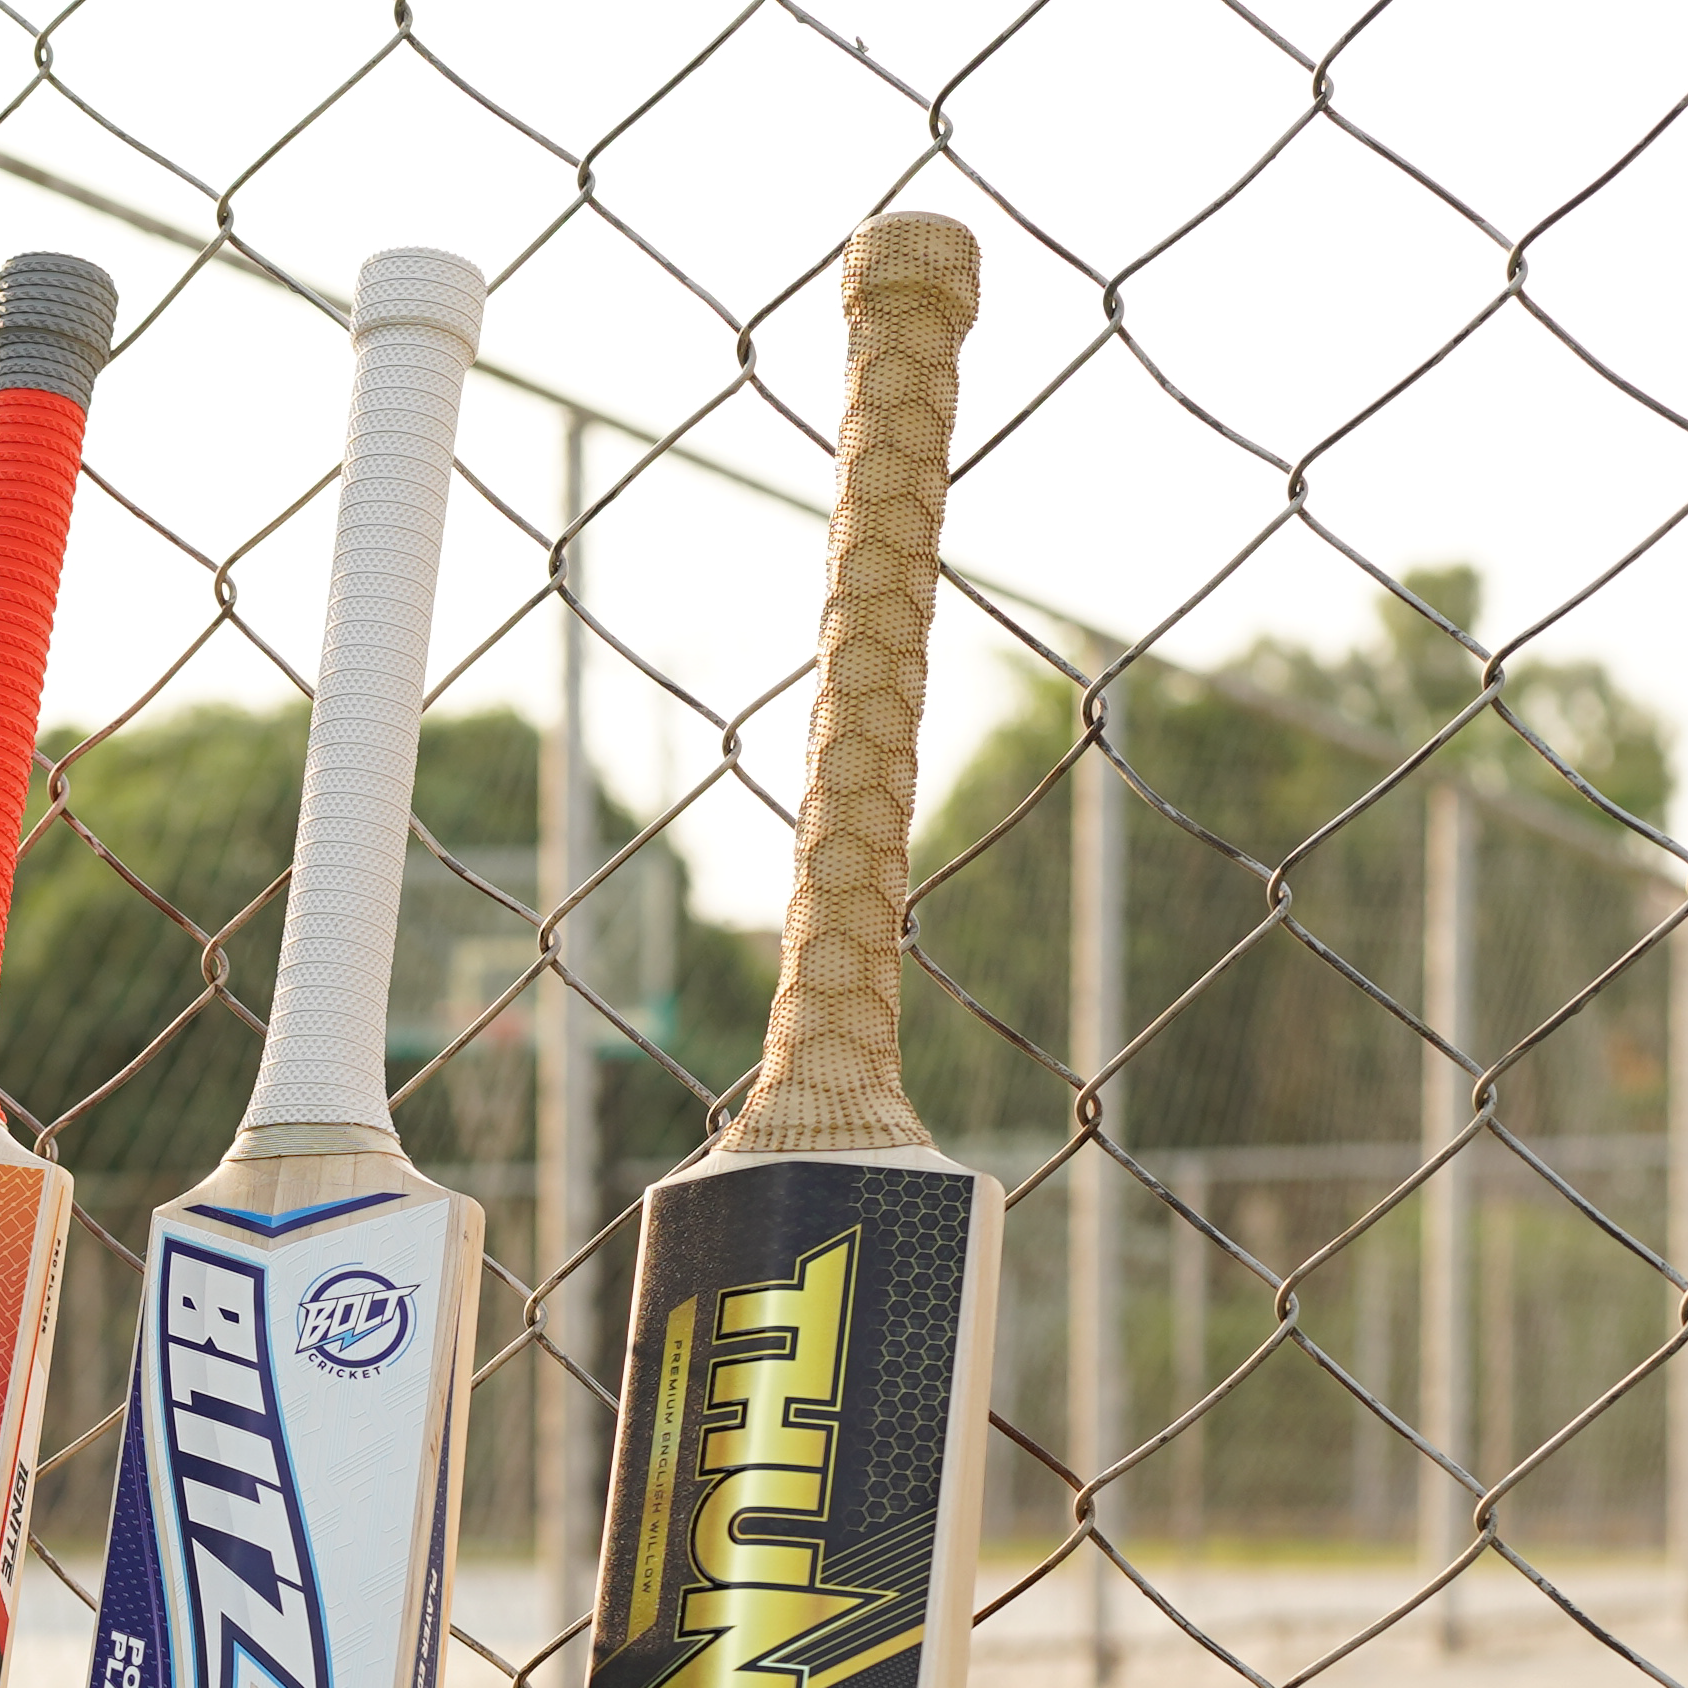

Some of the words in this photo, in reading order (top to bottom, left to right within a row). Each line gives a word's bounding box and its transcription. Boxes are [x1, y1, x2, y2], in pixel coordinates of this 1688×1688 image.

[52, 1238, 61, 1268] PRO
[41, 1275, 56, 1334] PLAYER
[295, 1284, 421, 1354] BOLT
[308, 1353, 381, 1380] CRICKET
[663, 1339, 683, 1424] PREMIUM
[653, 1431, 671, 1514] ENGLISH
[1, 1458, 29, 1587] IGNITE
[641, 1520, 659, 1594] WILLOW
[421, 1567, 437, 1659] PLAYER
